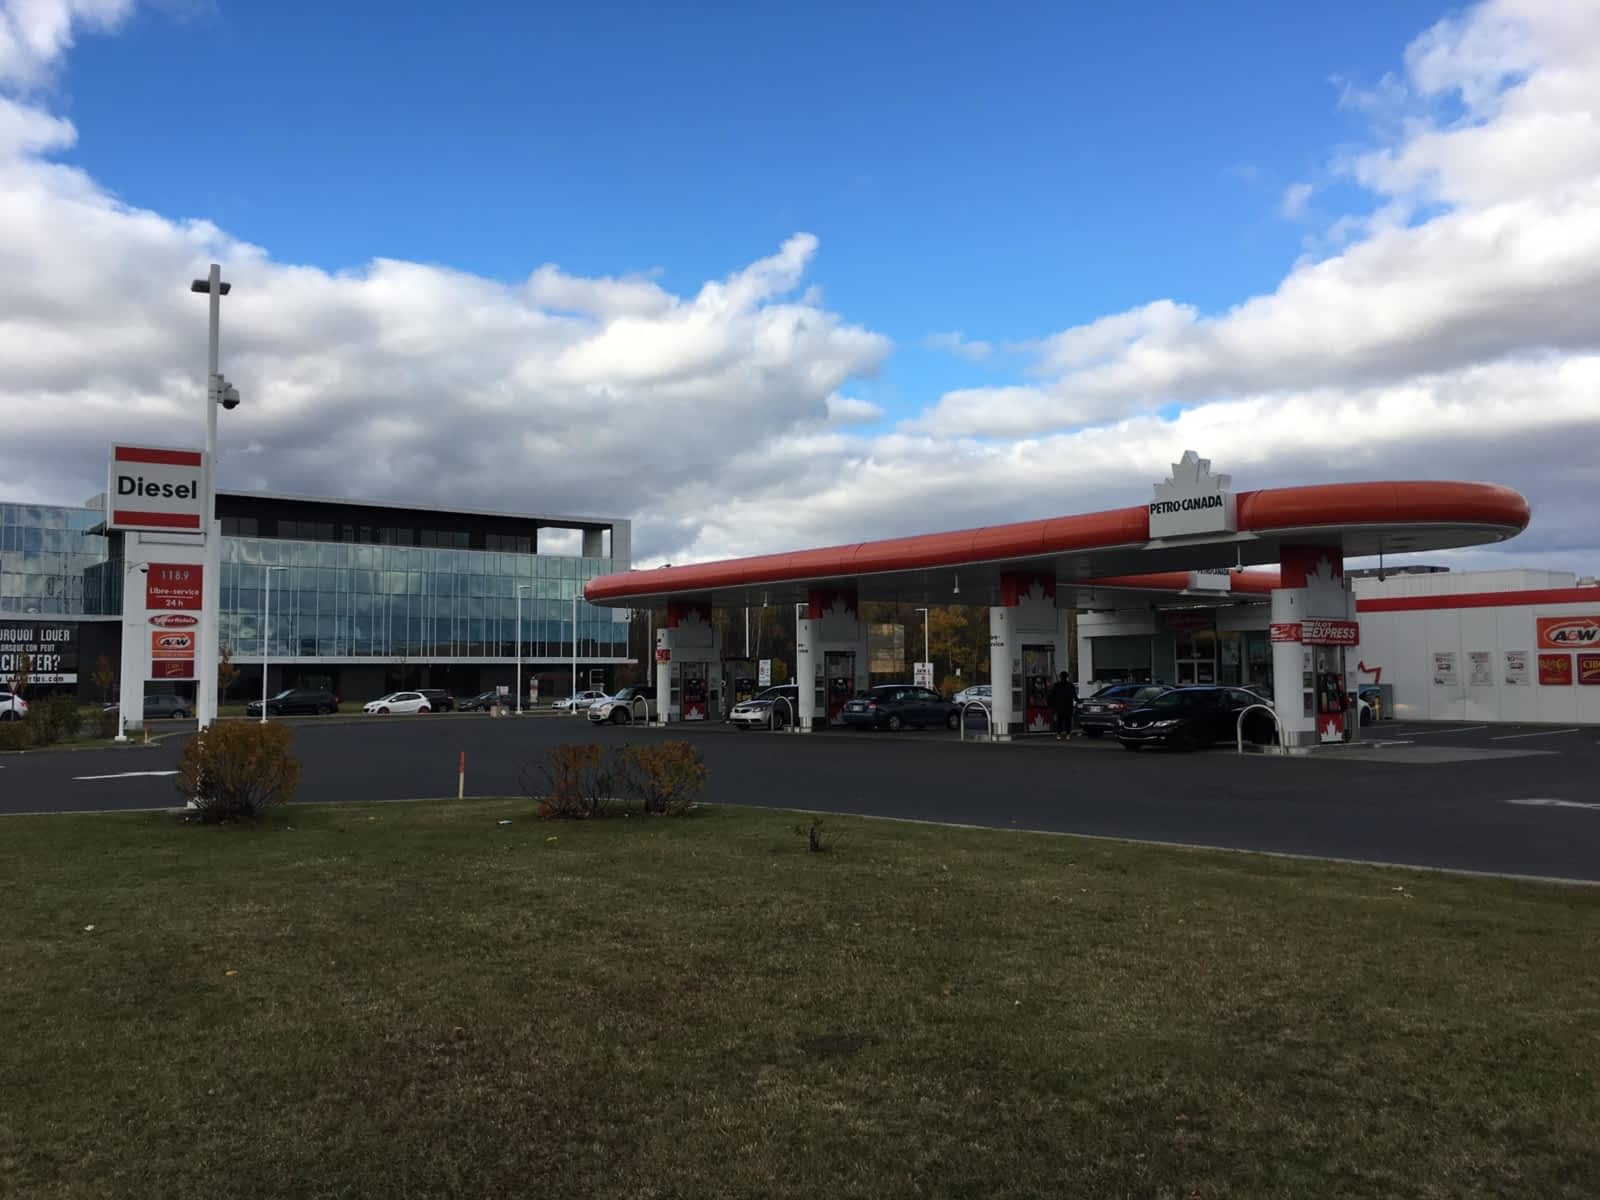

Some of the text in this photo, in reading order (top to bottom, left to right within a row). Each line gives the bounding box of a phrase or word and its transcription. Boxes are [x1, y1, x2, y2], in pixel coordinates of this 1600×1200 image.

[117, 475, 197, 499] Diesel
[41, 629, 70, 641] LOUER
[1312, 627, 1356, 639] EXPRESS
